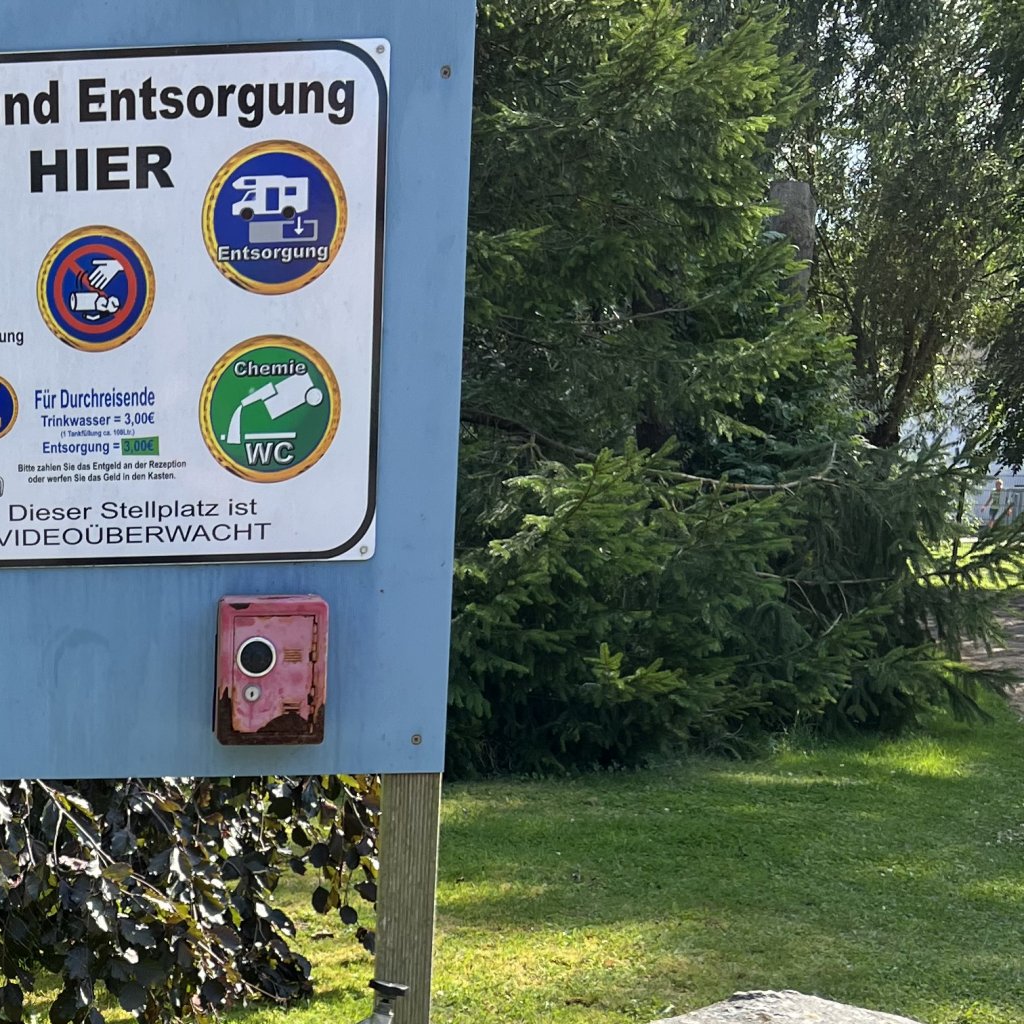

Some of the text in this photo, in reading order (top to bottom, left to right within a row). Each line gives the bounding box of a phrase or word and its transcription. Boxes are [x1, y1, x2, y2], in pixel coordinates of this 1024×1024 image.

[79, 75, 356, 129] Entsorgung
[30, 145, 175, 194] HIER
[217, 244, 329, 263] Entsorgung
[234, 360, 307, 377] Chemie
[34, 386, 156, 409] Für Durchreisende
[41, 414, 111, 427] Trinkwasser
[124, 412, 155, 426] 3,00€
[42, 441, 110, 456] Entsorgung
[123, 440, 154, 453] 3,00€
[245, 441, 295, 465] WC
[18, 462, 36, 472] Bitte
[37, 462, 61, 472] zahlen
[63, 462, 75, 471] Sie
[77, 461, 91, 471] das
[92, 461, 122, 473] Entgeld
[134, 461, 147, 470] der
[148, 460, 187, 471] Rezeption
[27, 470, 176, 484] oder werfen Sie das Geld in den Kasten.
[8, 498, 258, 524] Dieser Stellplatz ist
